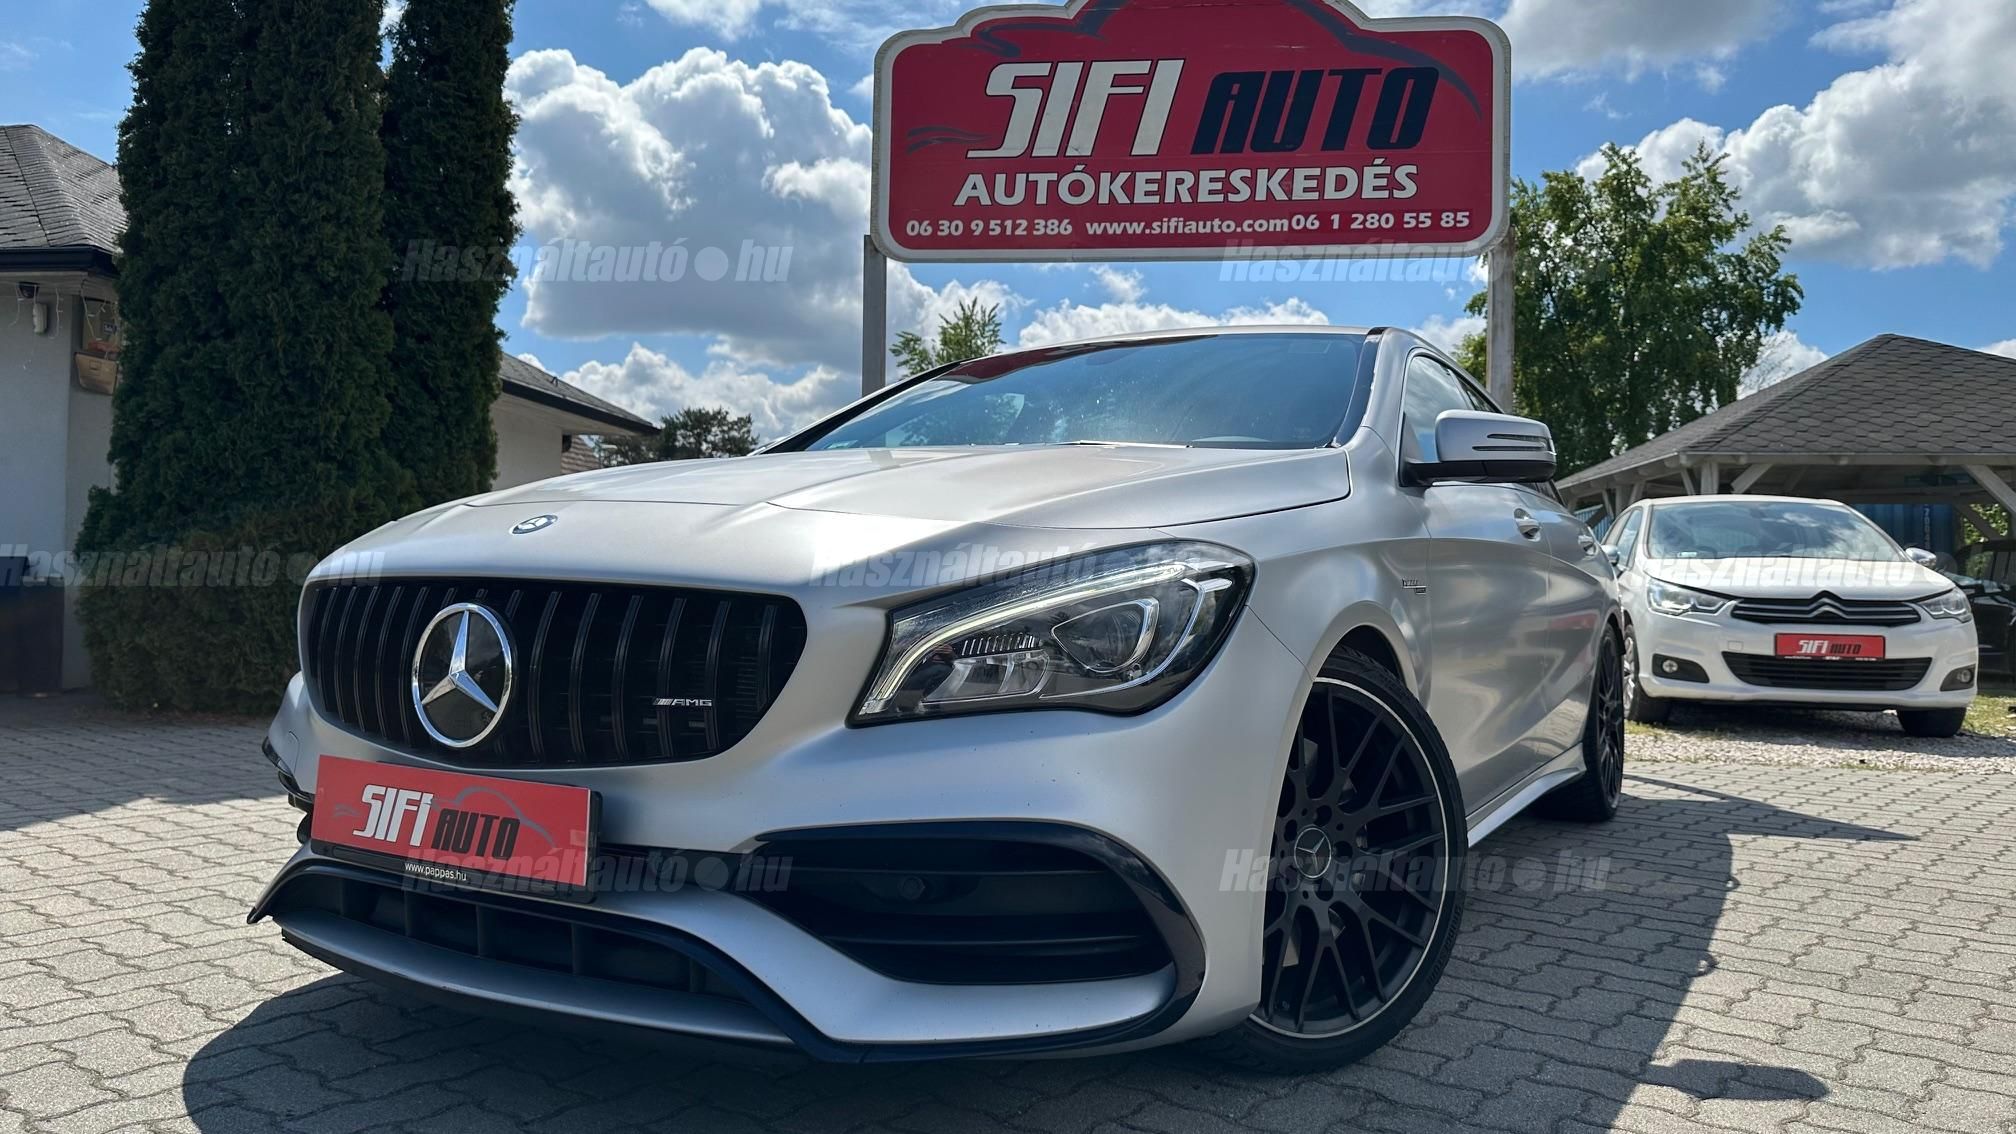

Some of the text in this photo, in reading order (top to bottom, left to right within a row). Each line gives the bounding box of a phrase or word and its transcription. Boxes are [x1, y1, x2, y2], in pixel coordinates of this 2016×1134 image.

[965, 58, 1440, 159] SIFI AUTO
[953, 158, 1419, 207] AUTÓKERESKEDÉS
[906, 211, 1470, 236] 06 30 9 512 386 www.sifiauto.com 06 1 280 55 85
[1796, 639, 1829, 654] SIFI
[353, 783, 521, 860] SIFI AUTO
[404, 862, 467, 881] www.pappas.hu
